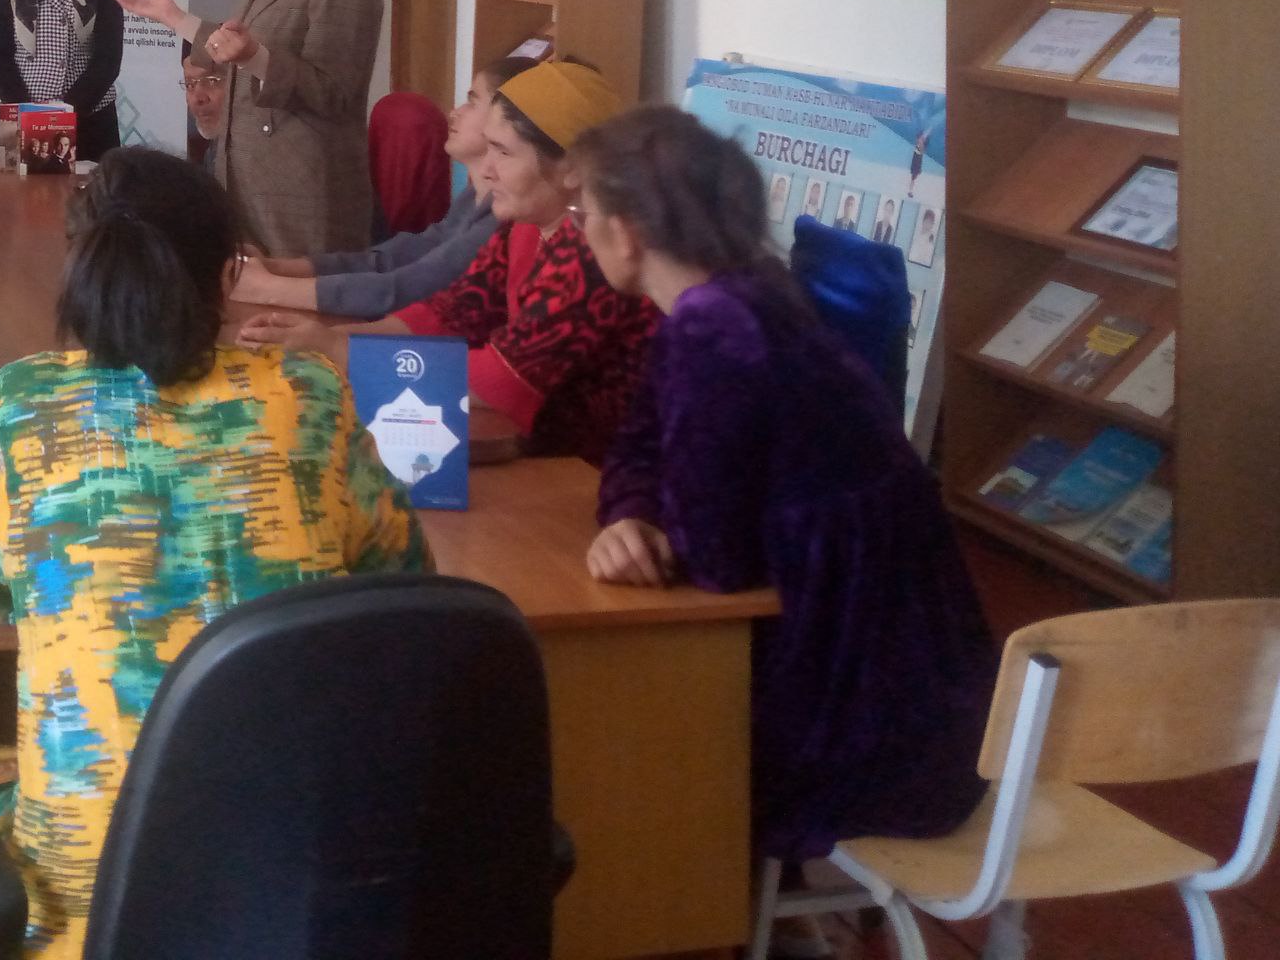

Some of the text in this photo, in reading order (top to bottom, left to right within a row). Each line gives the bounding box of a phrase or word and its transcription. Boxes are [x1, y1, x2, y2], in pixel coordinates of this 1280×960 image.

[128, 27, 149, 35] avvalo
[157, 39, 176, 48] kerak
[754, 131, 851, 176] BURCHAGI
[396, 357, 418, 374] 20
